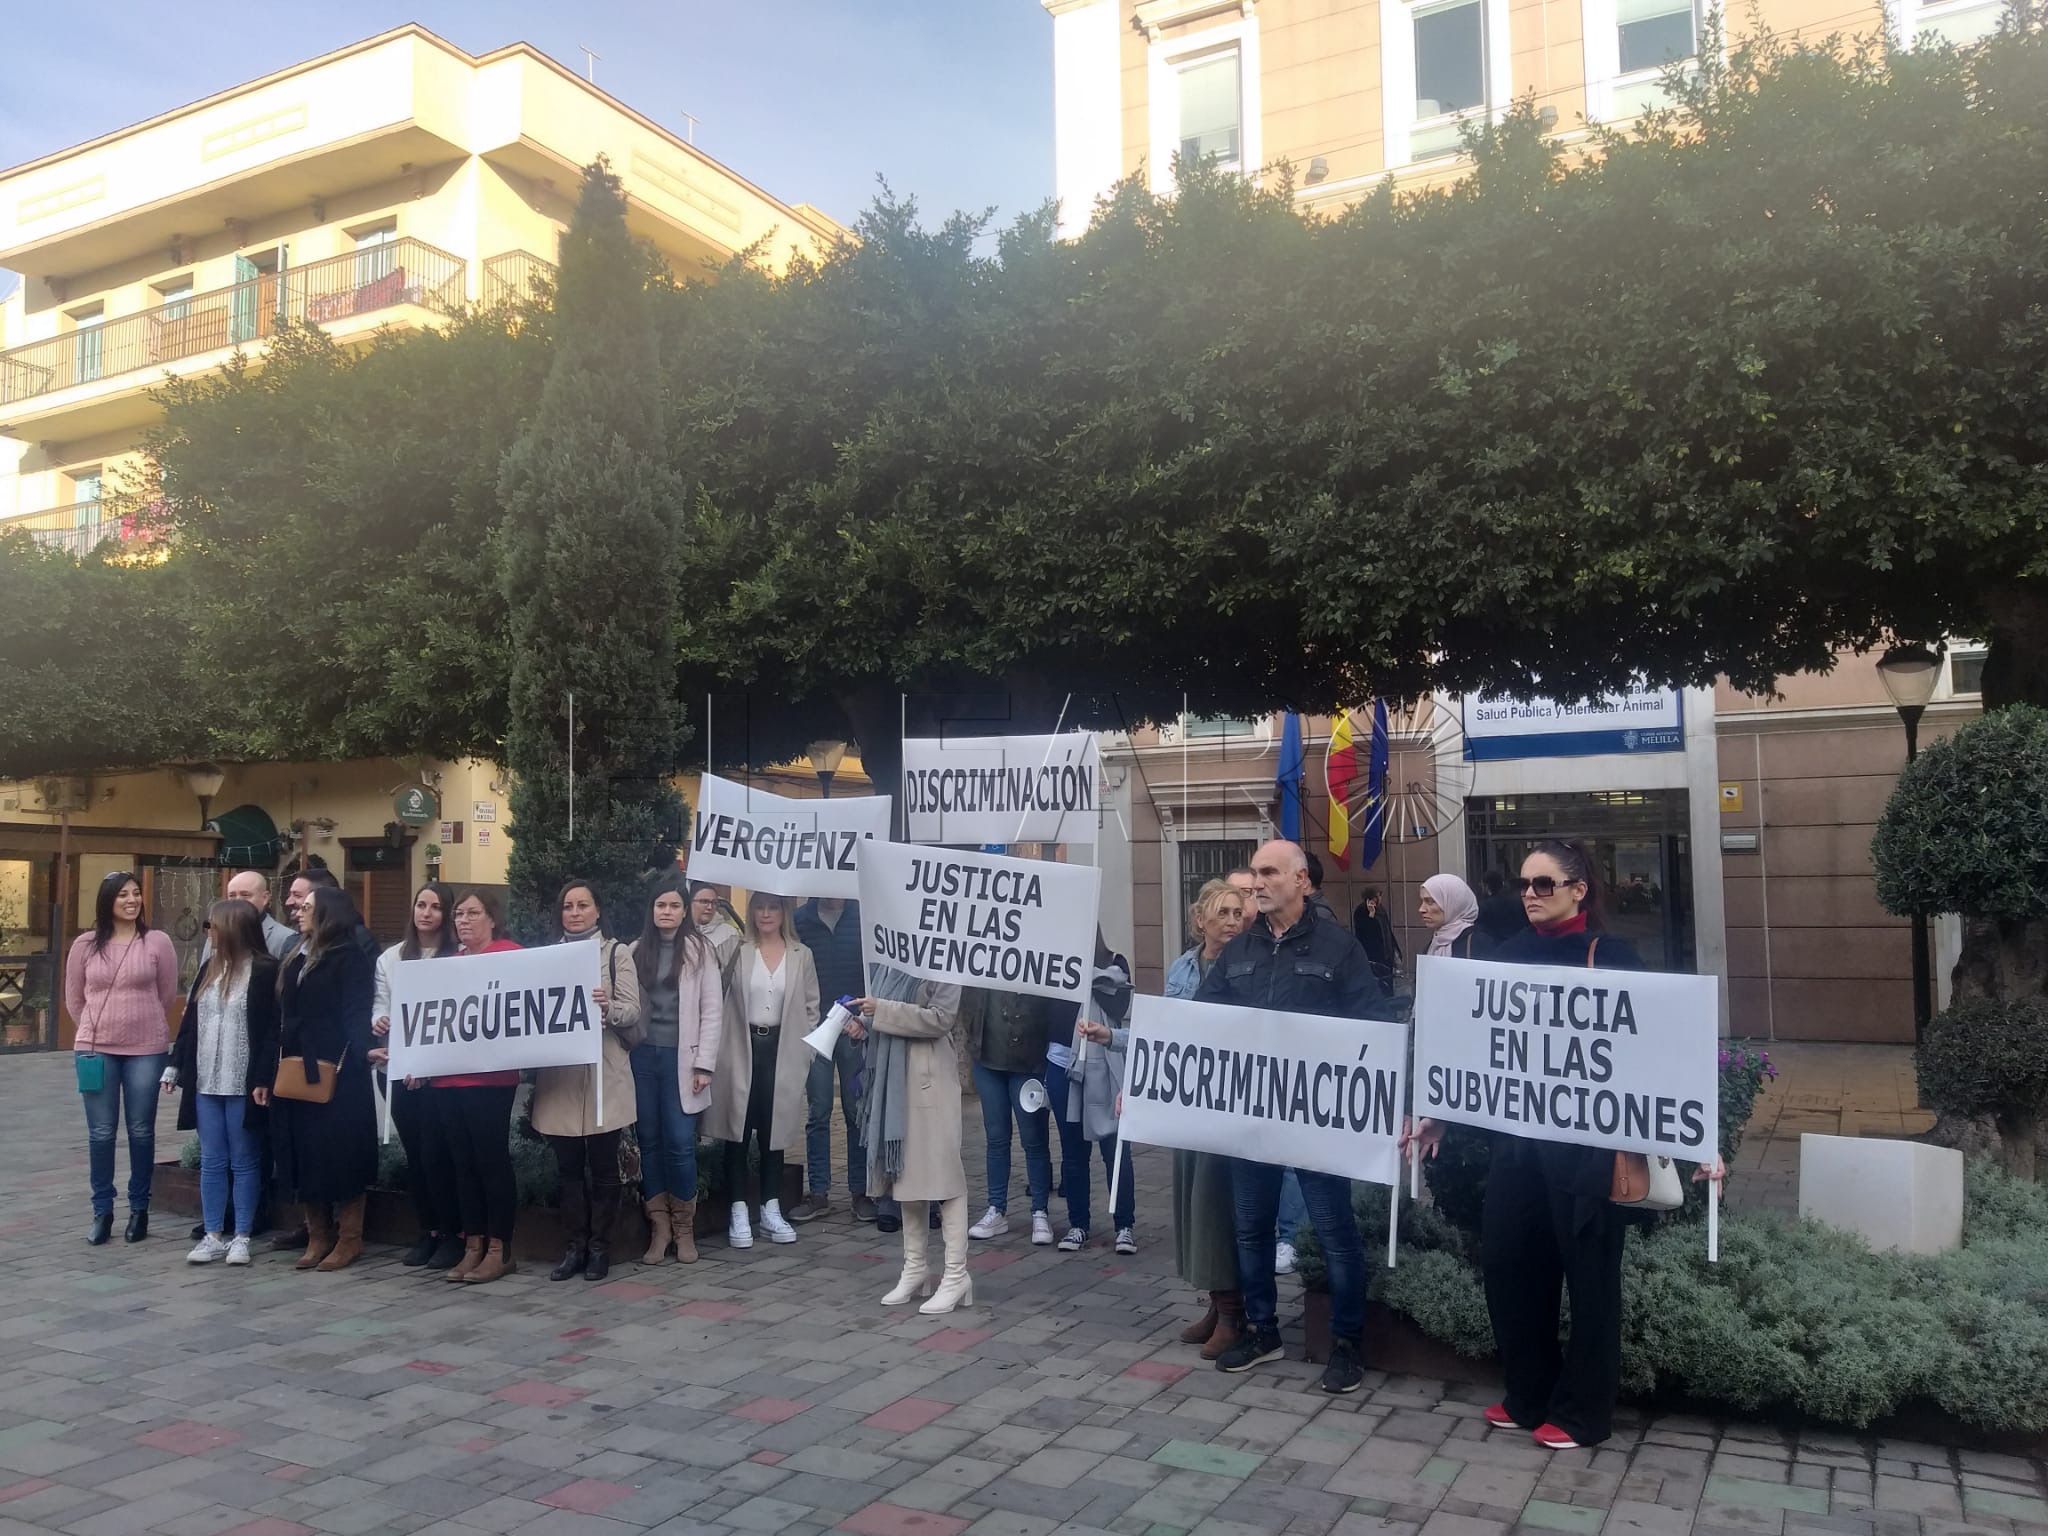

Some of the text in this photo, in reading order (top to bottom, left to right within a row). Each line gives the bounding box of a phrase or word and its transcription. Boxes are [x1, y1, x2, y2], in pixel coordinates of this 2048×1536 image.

[1476, 698, 1664, 721] Salud Pública y Bienestar Animal
[1641, 735, 1680, 745] MELILLA
[906, 749, 1093, 814] DISCRIMINACIÓN
[694, 811, 876, 872] VERGÜENZ
[905, 859, 1043, 908] JUSTICIA
[919, 898, 1022, 943] EN LAS
[873, 923, 1083, 991] SUBVENCIONES
[401, 980, 591, 1048] VERGÜENZA
[1471, 978, 1638, 1035] JUSTICIA
[1489, 1026, 1613, 1083] EN LAS
[1129, 1037, 1397, 1137] DISCRIMINACIÓN
[1427, 1065, 1705, 1147] SUBVENCIONES
